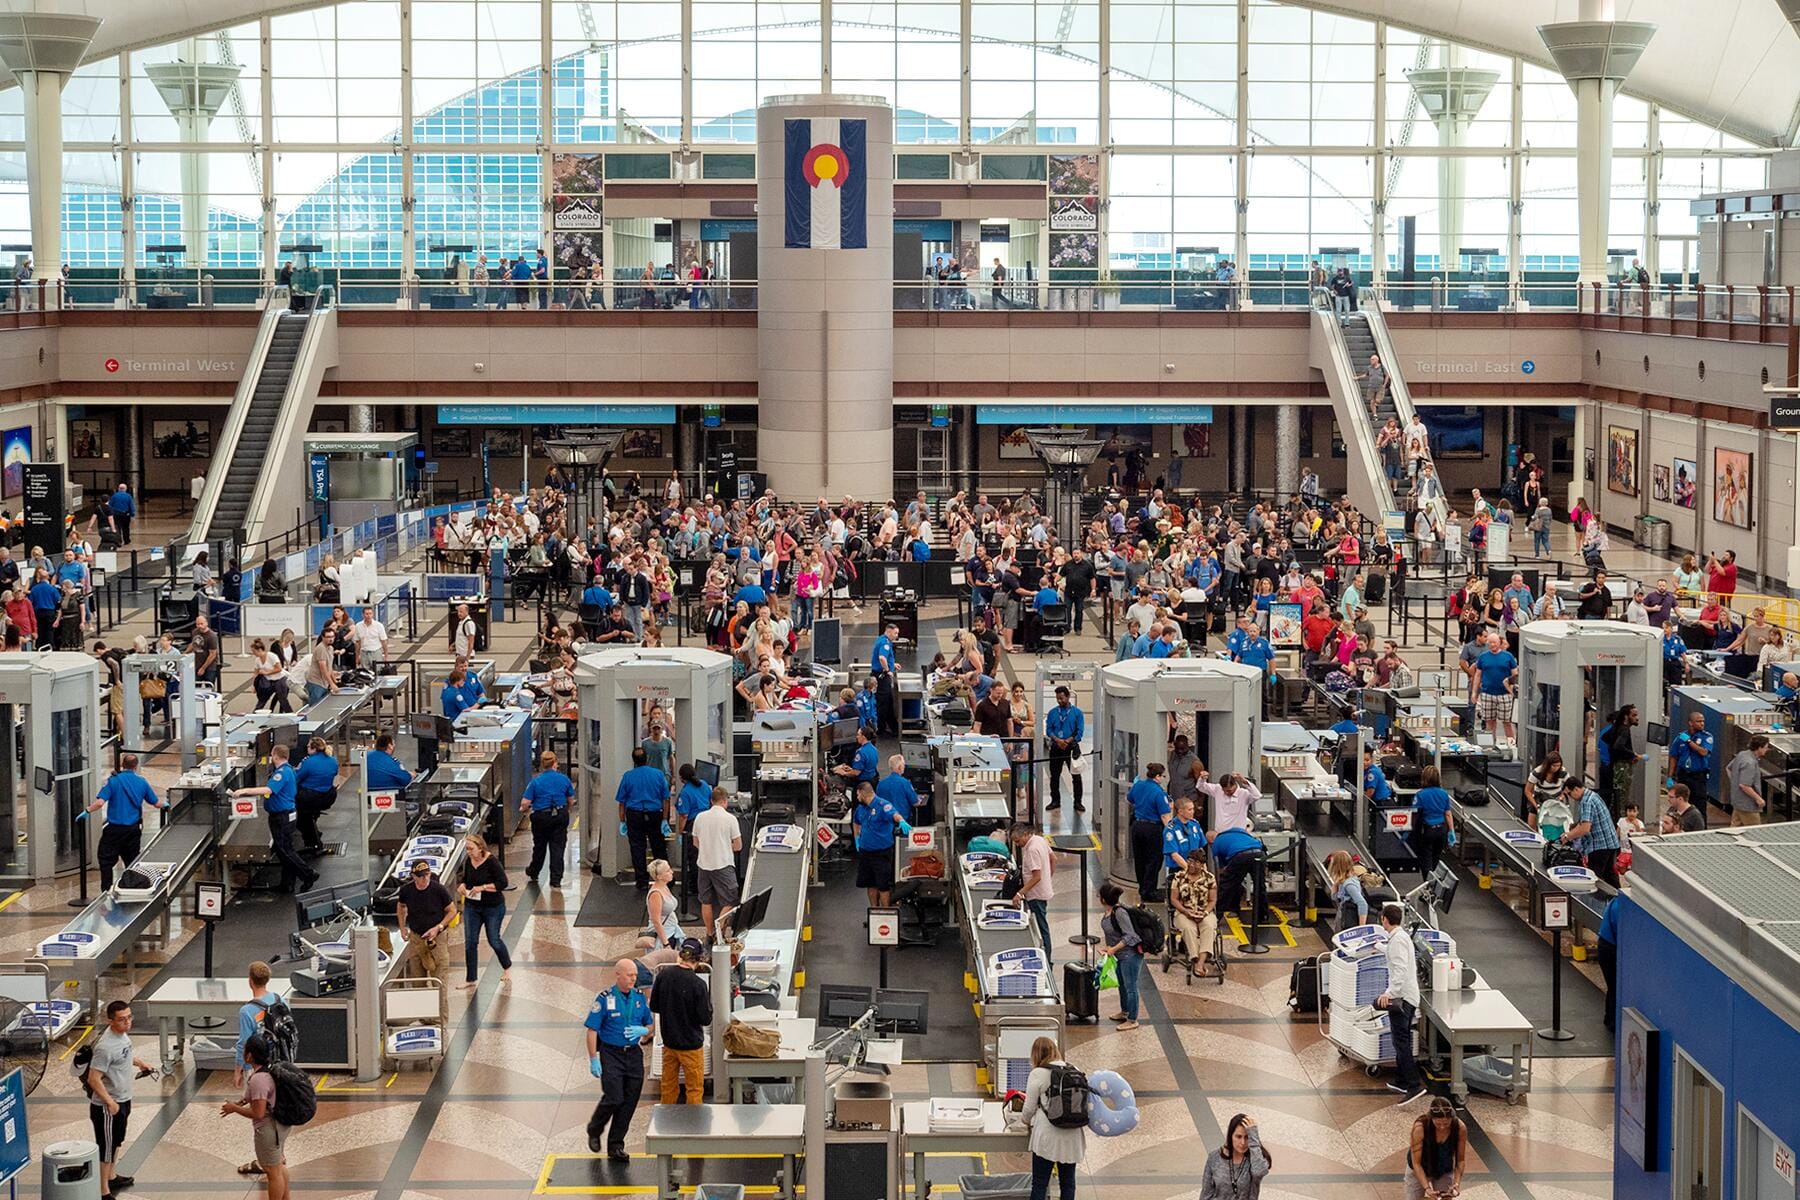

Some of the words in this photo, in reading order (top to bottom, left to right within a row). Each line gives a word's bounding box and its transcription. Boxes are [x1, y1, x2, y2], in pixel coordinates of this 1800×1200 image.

[126, 359, 190, 371] Terminal
[197, 360, 236, 371] West
[1416, 360, 1478, 373] Terminal
[1485, 361, 1517, 373] East
[316, 469, 324, 483] TSA
[167, 660, 176, 671] 2
[819, 828, 829, 839] STOP
[1775, 1152, 1792, 1177] EXIT
